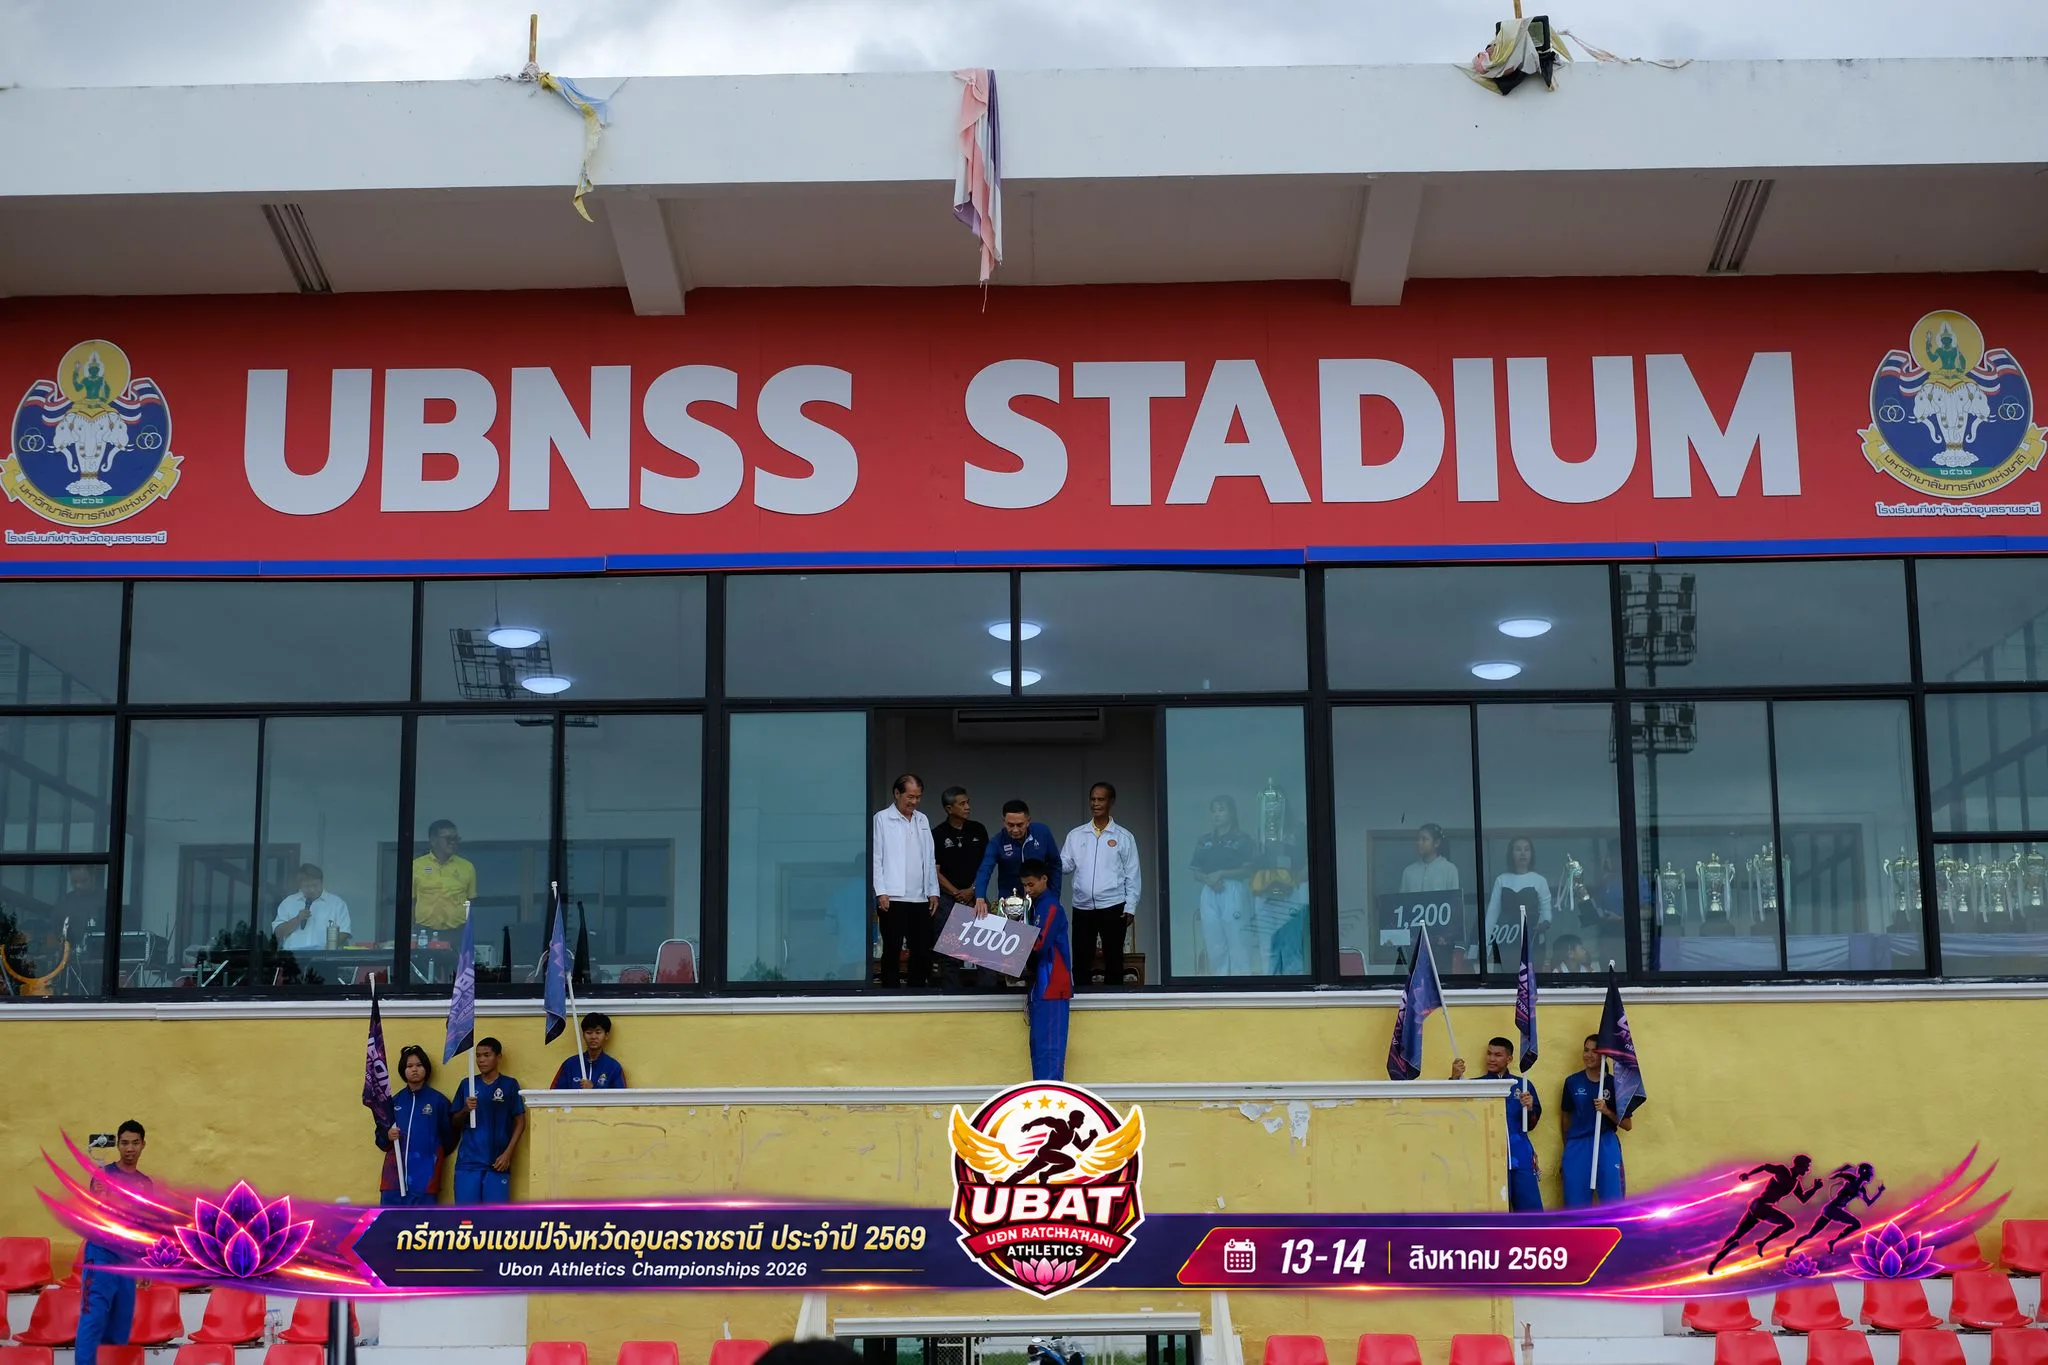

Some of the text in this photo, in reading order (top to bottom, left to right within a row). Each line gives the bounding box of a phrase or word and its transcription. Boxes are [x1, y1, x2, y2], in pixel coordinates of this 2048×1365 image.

[244, 352, 1801, 515] UBNSS STADIUM
[1394, 902, 1452, 930] 1,200
[958, 921, 1021, 956] 1,000
